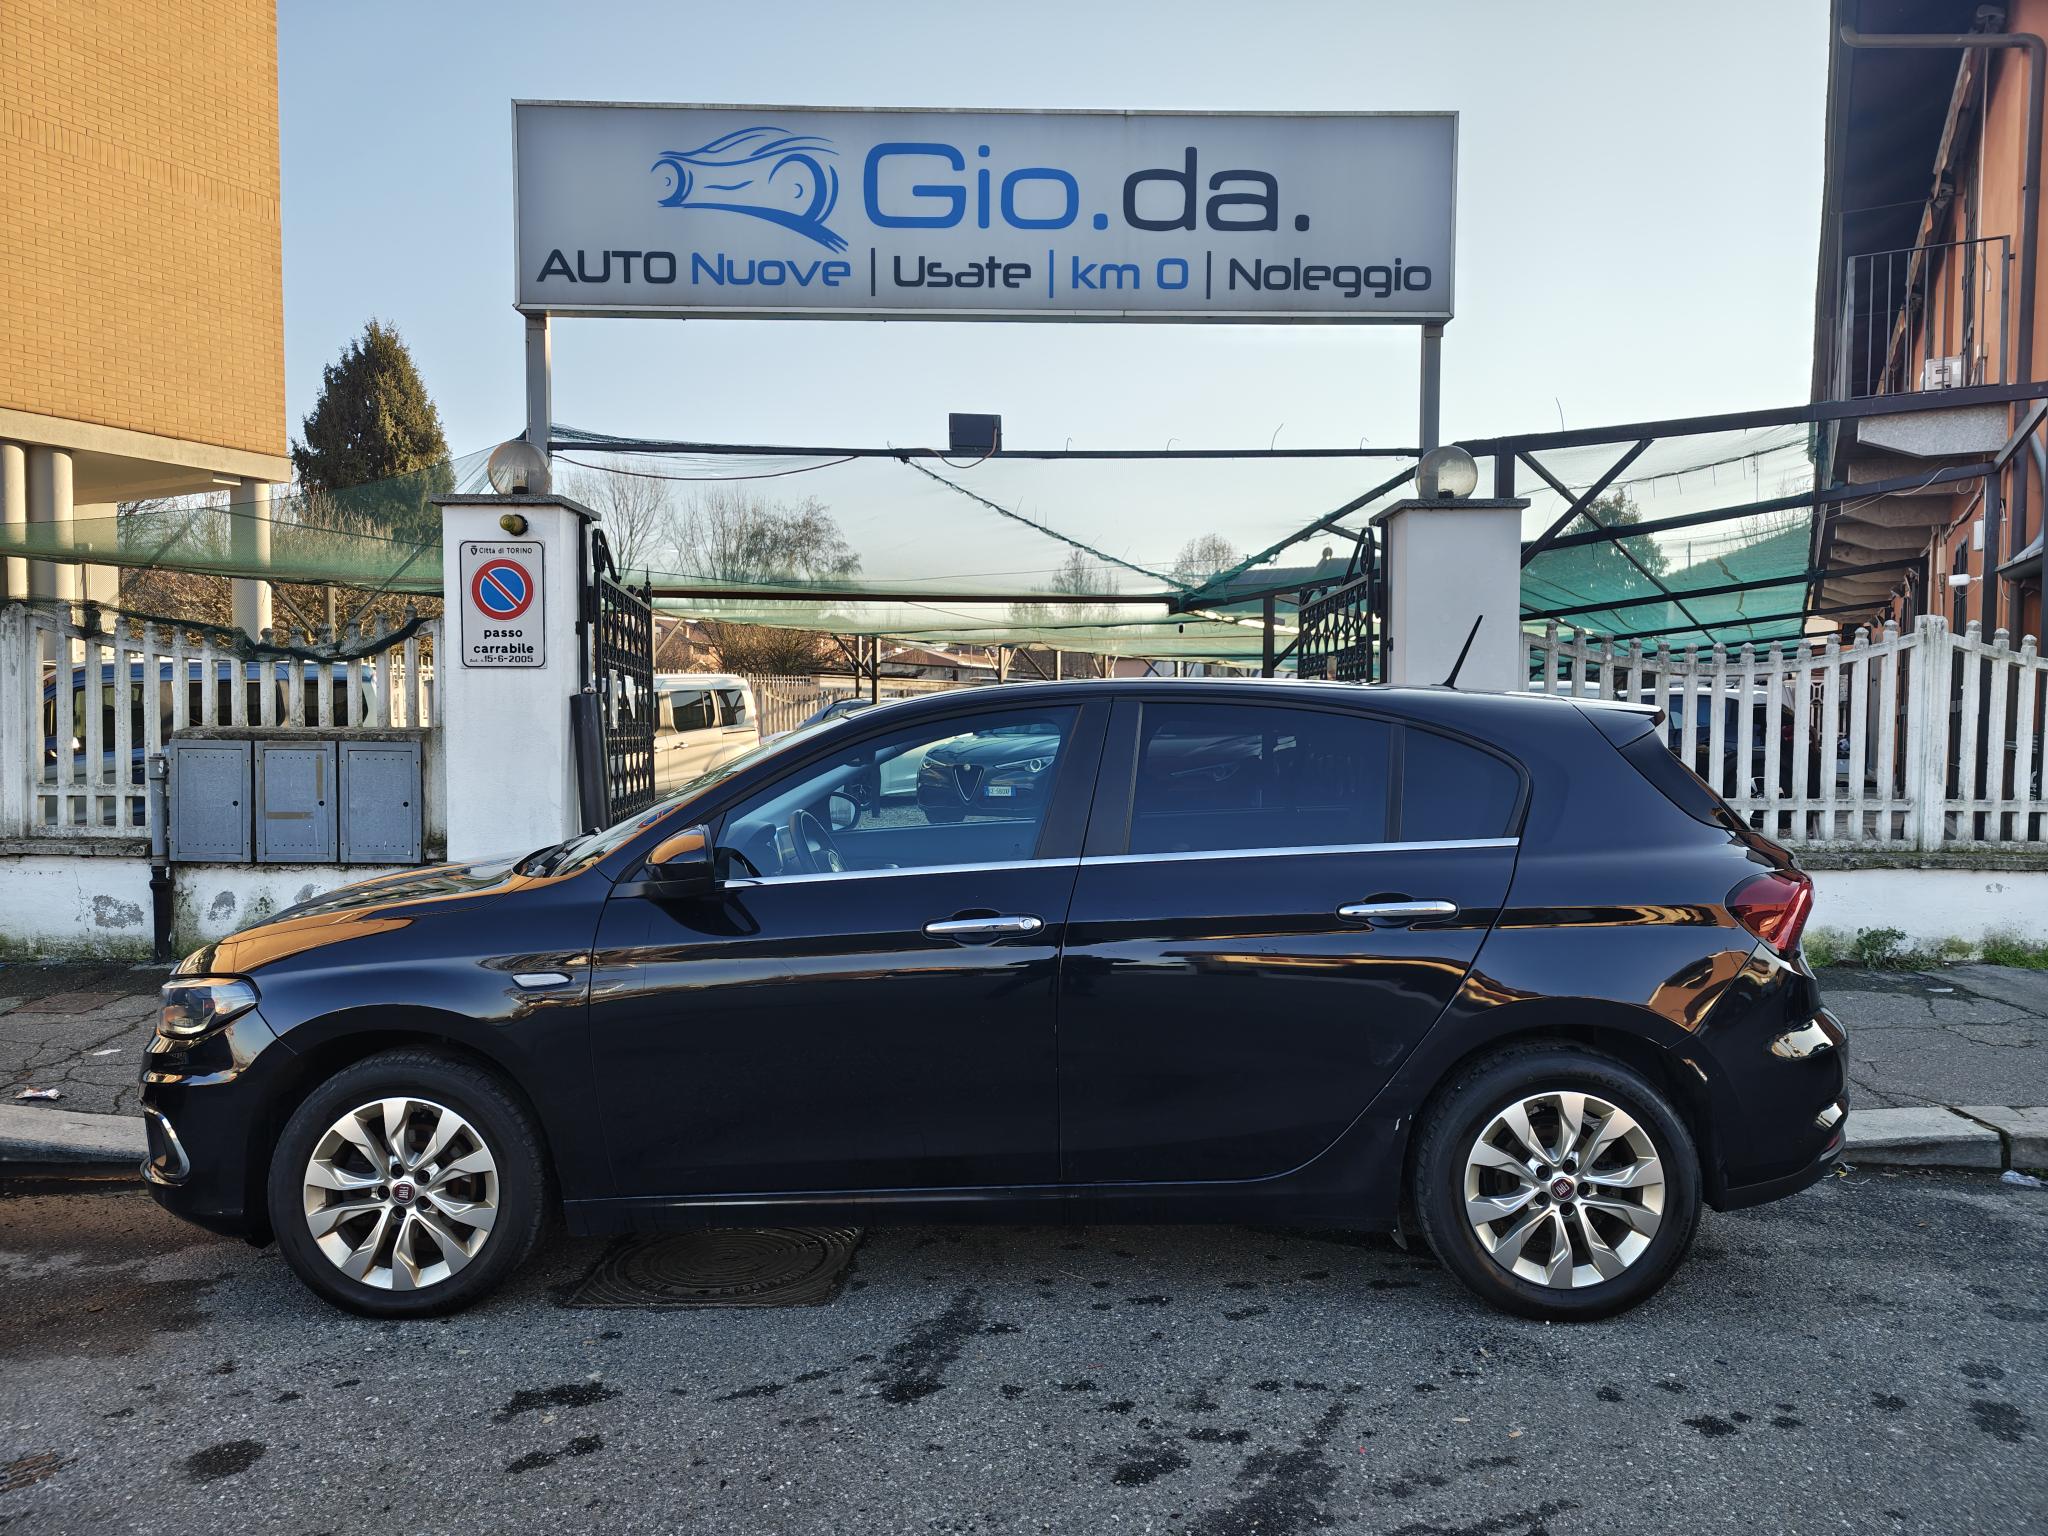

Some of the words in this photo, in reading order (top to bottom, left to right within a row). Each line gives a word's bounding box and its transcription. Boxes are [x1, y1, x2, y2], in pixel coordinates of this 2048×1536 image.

[863, 142, 1310, 232] Gio.da.
[536, 248, 677, 284] AUTO
[691, 252, 851, 287] Nuove
[893, 255, 1032, 288] Usate
[1071, 255, 1141, 290] km
[1228, 257, 1432, 298] Noleggio
[484, 629, 523, 639] passo
[473, 643, 534, 654] carrabile
[398, 1186, 409, 1199] FIAT
[1555, 1181, 1570, 1196] FIAT
